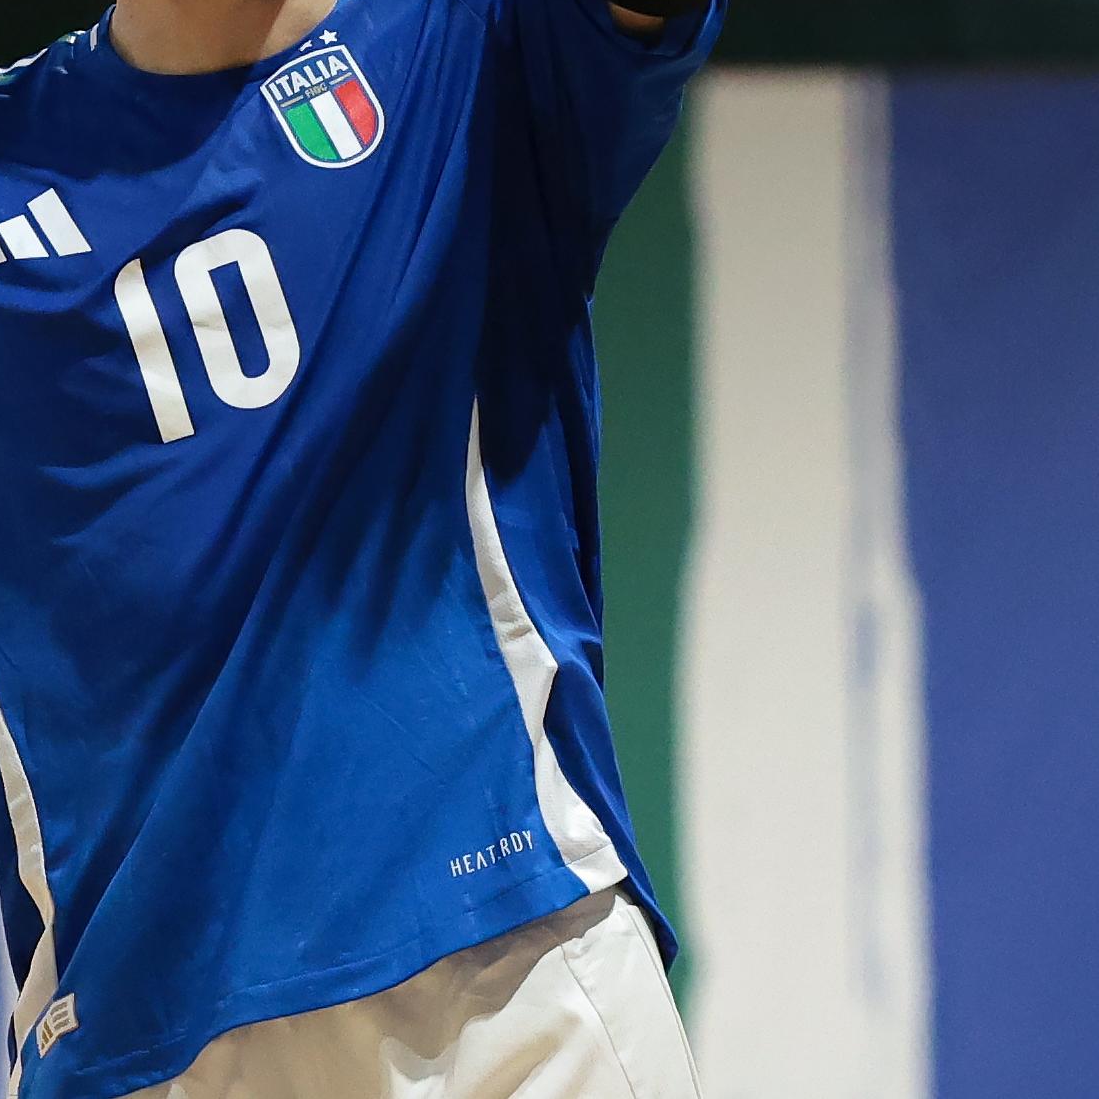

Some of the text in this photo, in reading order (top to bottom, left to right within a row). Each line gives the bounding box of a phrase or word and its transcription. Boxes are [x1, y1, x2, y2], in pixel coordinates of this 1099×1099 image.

[269, 55, 349, 101] ITALIA
[114, 228, 300, 444] 10
[450, 830, 533, 877] HEAT.RDY
